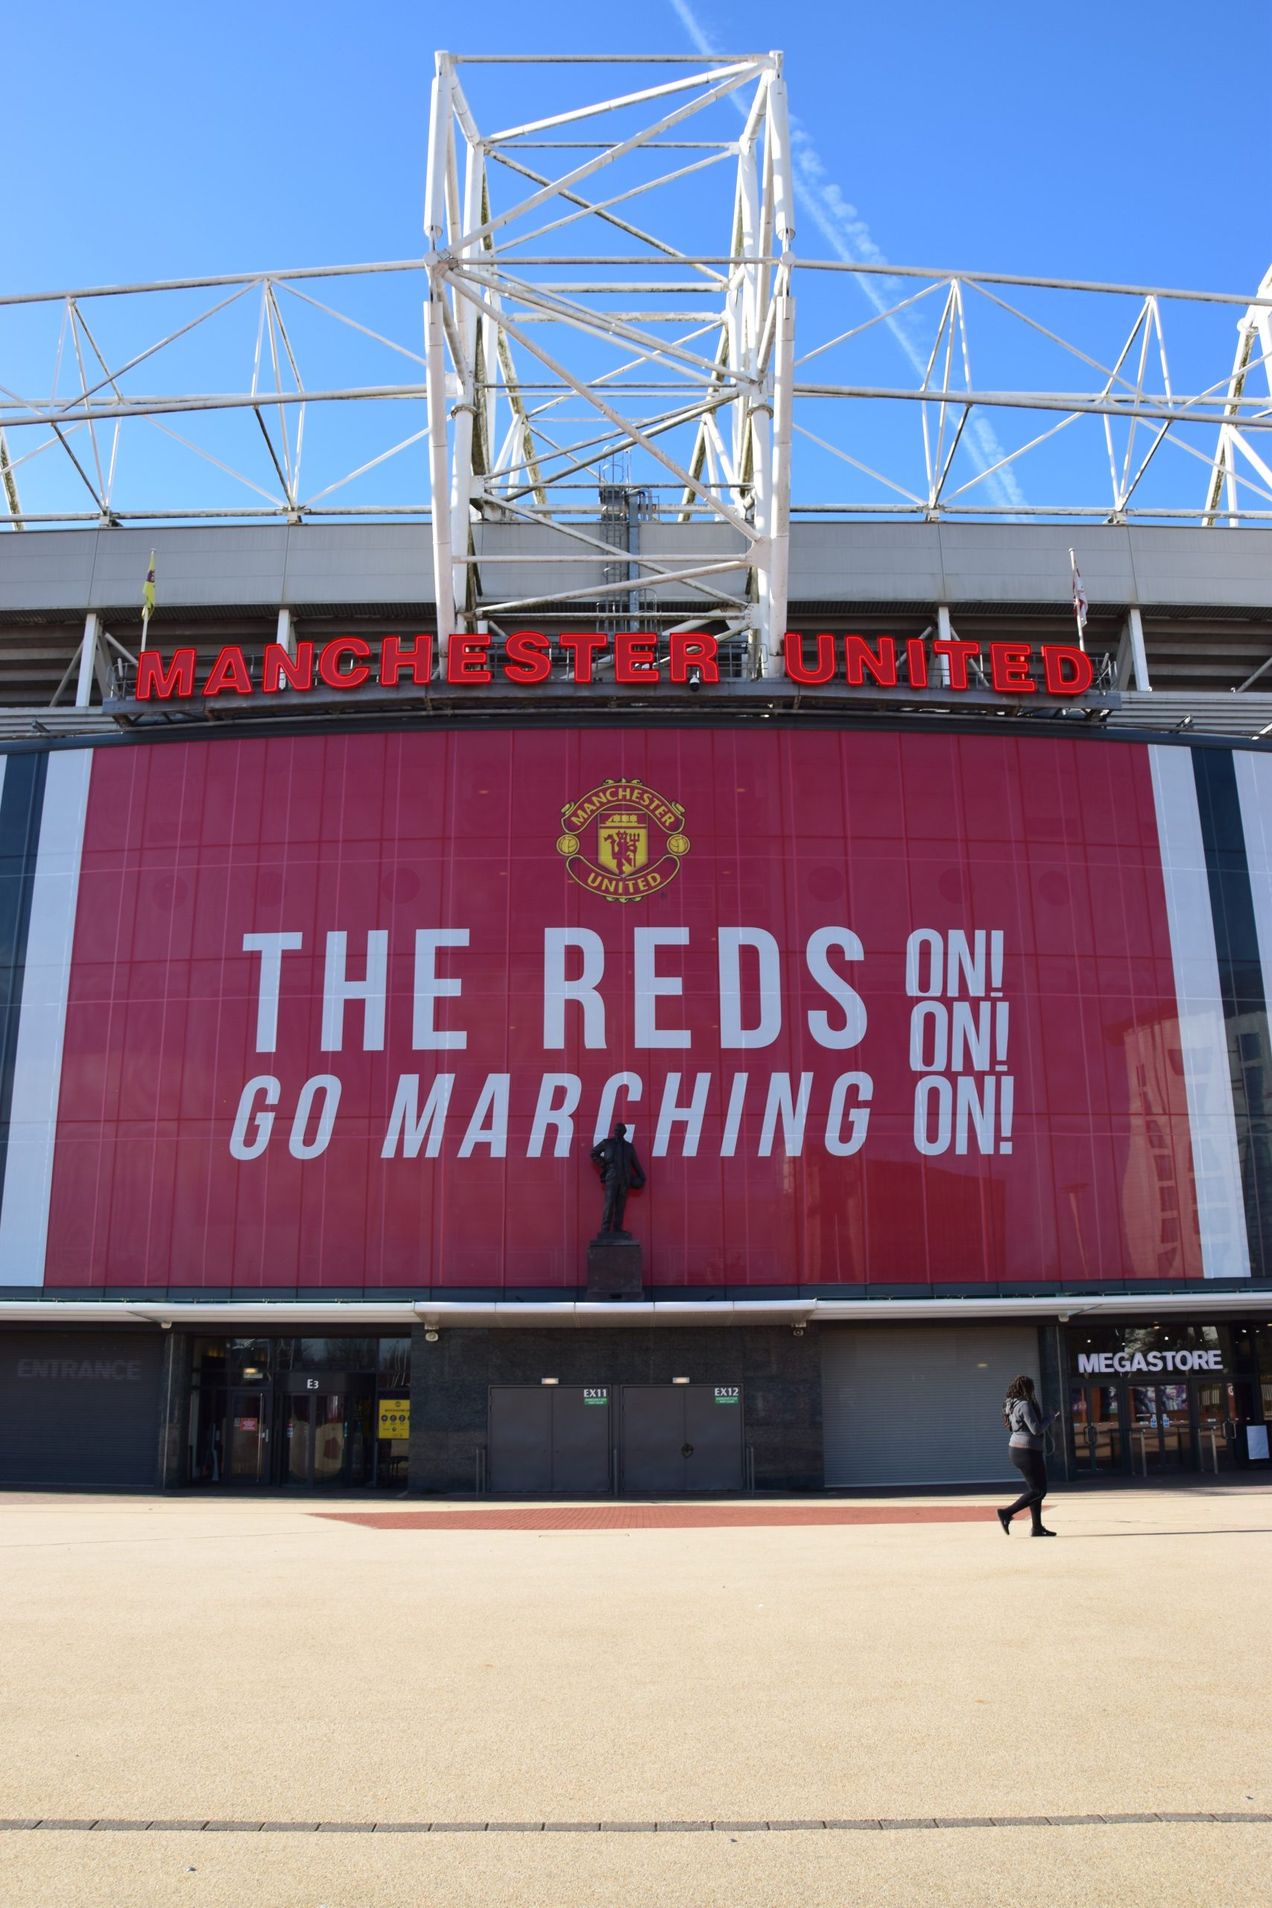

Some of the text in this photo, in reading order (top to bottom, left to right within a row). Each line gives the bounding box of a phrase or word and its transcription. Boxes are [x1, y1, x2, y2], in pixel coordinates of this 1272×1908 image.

[133, 629, 1095, 702] MANCHESTER UNITED
[571, 787, 675, 826] MANCHESTER
[587, 872, 661, 893] UNITED
[905, 928, 1004, 998] ON!
[242, 926, 868, 1053] THE REDS
[909, 1000, 1010, 1072] ON!
[229, 1071, 874, 1161] GO MARCHING
[913, 1074, 1014, 1156] ON!
[17, 1359, 142, 1380] ENTRANCE
[1077, 1349, 1224, 1373] MEGASTORE
[306, 1379, 319, 1389] E3
[583, 1388, 607, 1398] EX11
[714, 1387, 739, 1397] EX12
